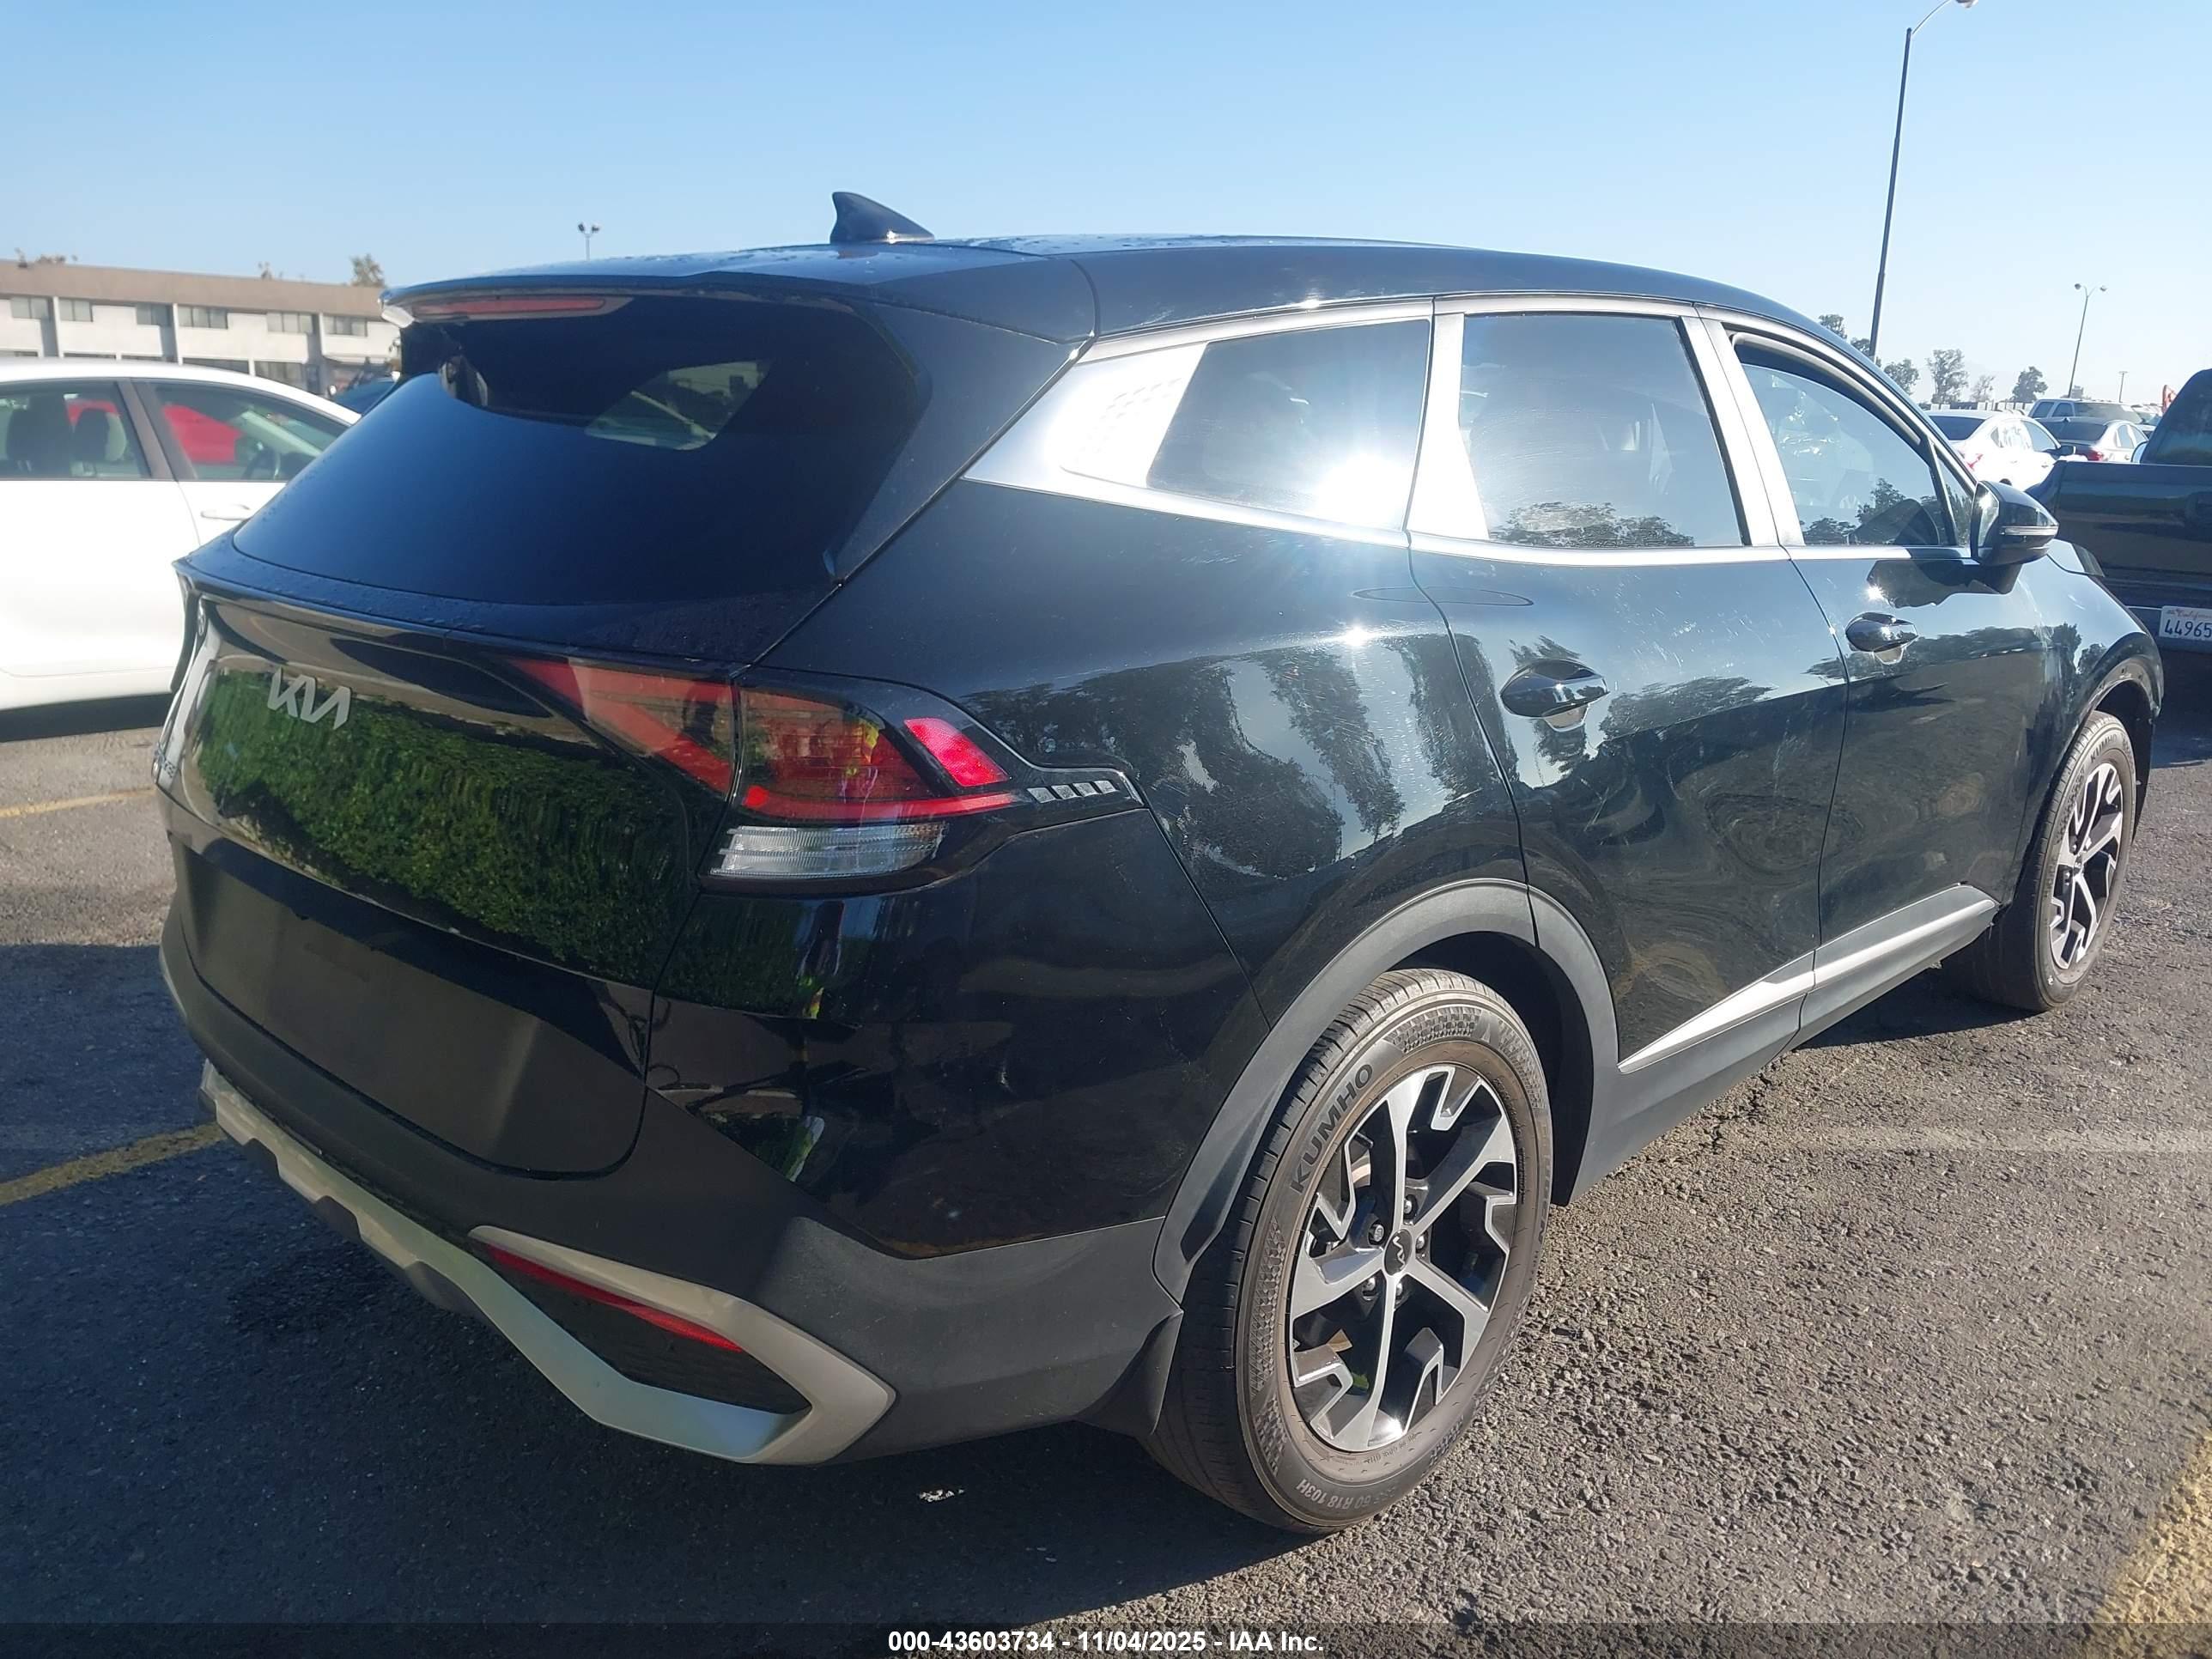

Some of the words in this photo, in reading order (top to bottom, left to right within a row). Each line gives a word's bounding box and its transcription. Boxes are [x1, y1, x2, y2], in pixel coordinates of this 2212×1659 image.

[2164, 618, 2212, 638] 44965
[267, 665, 351, 730] KIA
[1290, 1064, 1373, 1194] KUMHO
[1295, 1478, 1328, 1505] 103H
